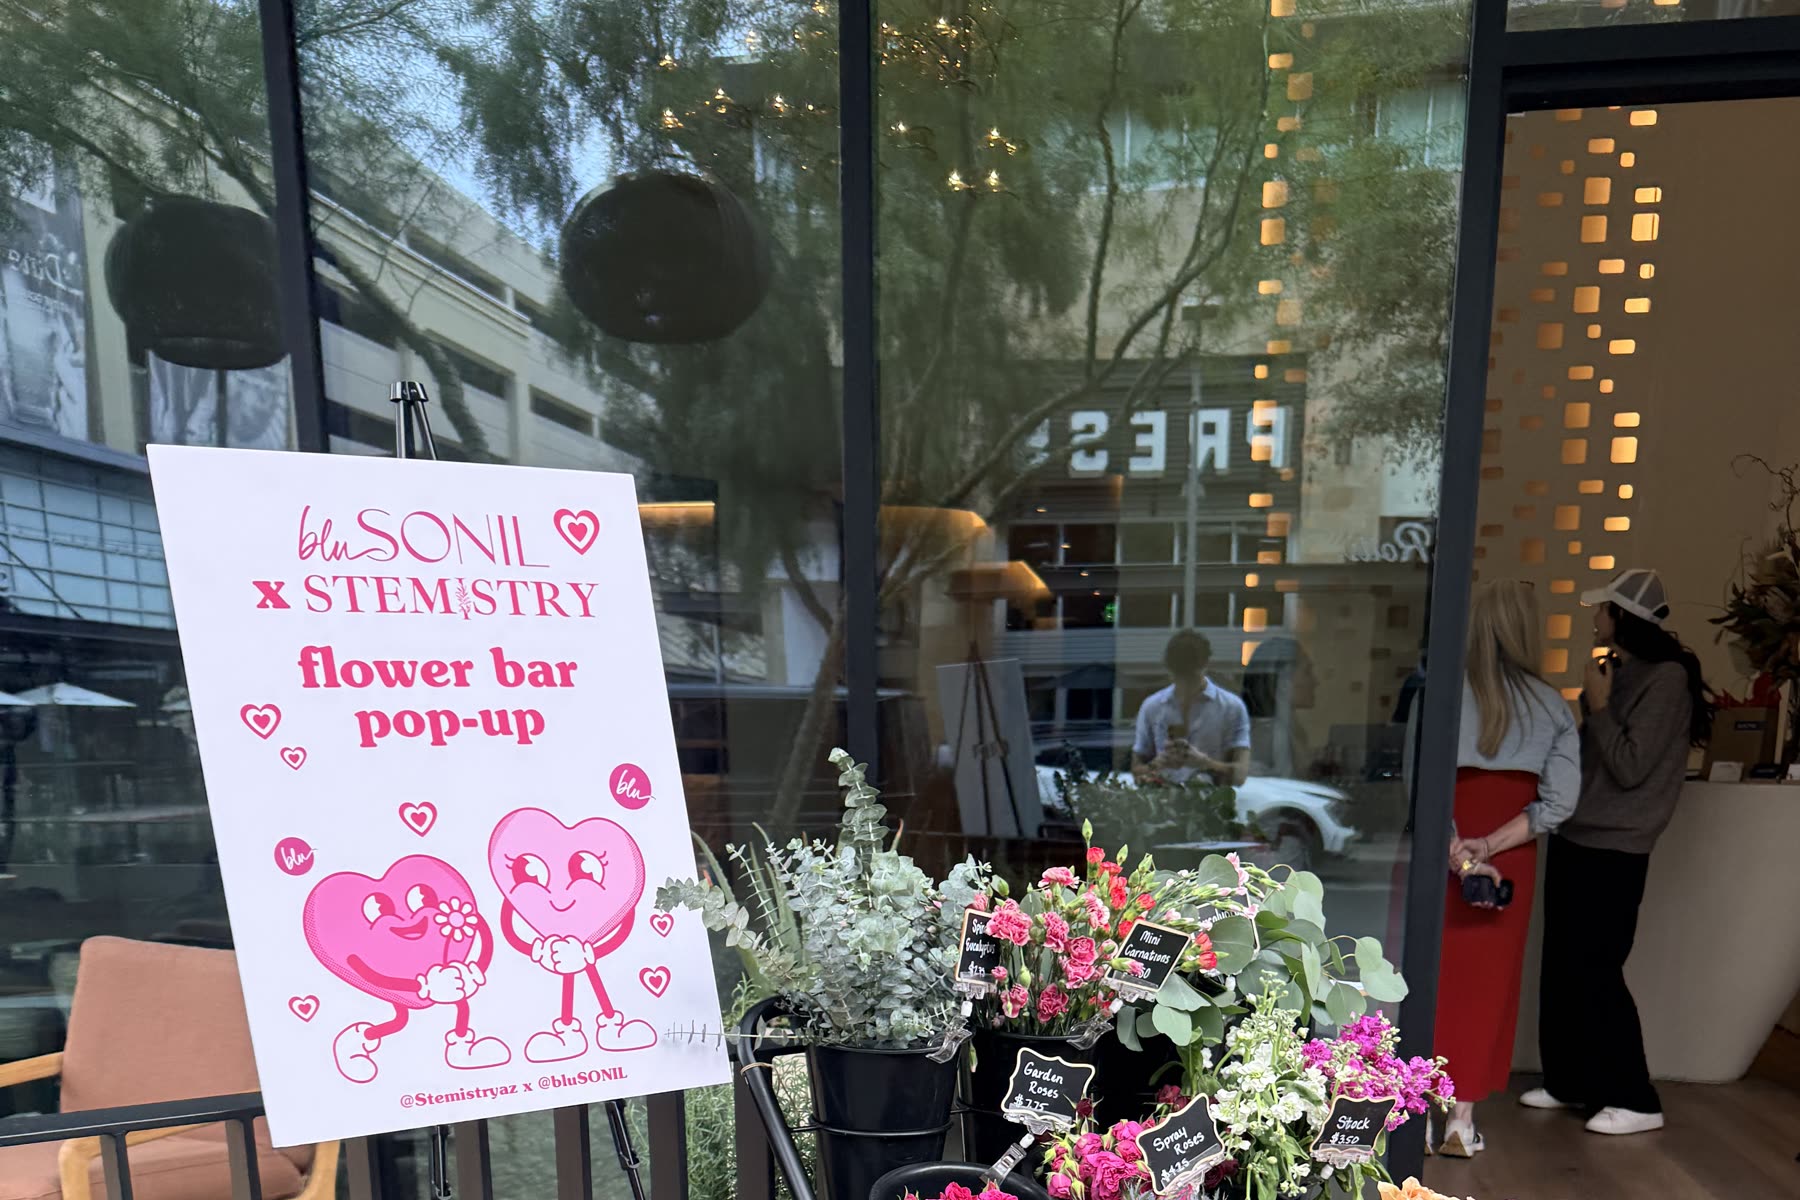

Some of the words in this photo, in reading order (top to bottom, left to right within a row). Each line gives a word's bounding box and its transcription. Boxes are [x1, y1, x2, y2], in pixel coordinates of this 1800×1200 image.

[251, 580, 292, 610] x
[303, 574, 600, 621] STEMISTRY
[297, 645, 475, 689] flower
[488, 646, 579, 689] bar
[353, 708, 546, 748] pop-up
[615, 768, 657, 801] blu
[279, 846, 319, 871] blu
[965, 937, 996, 959] Eucalyptus
[1140, 930, 1163, 946] Mini
[1124, 943, 1172, 965] Carnations
[1023, 1061, 1064, 1085] Garden
[400, 1083, 518, 1109] @Stemistryaz
[522, 1081, 533, 1093] x
[537, 1066, 628, 1090] @bluSONIL
[1028, 1080, 1059, 1099] Roses
[1013, 1093, 1050, 1112] $7.75
[1336, 1115, 1371, 1130] Stock
[1152, 1126, 1188, 1152] Spray
[1173, 1131, 1205, 1156] Roses
